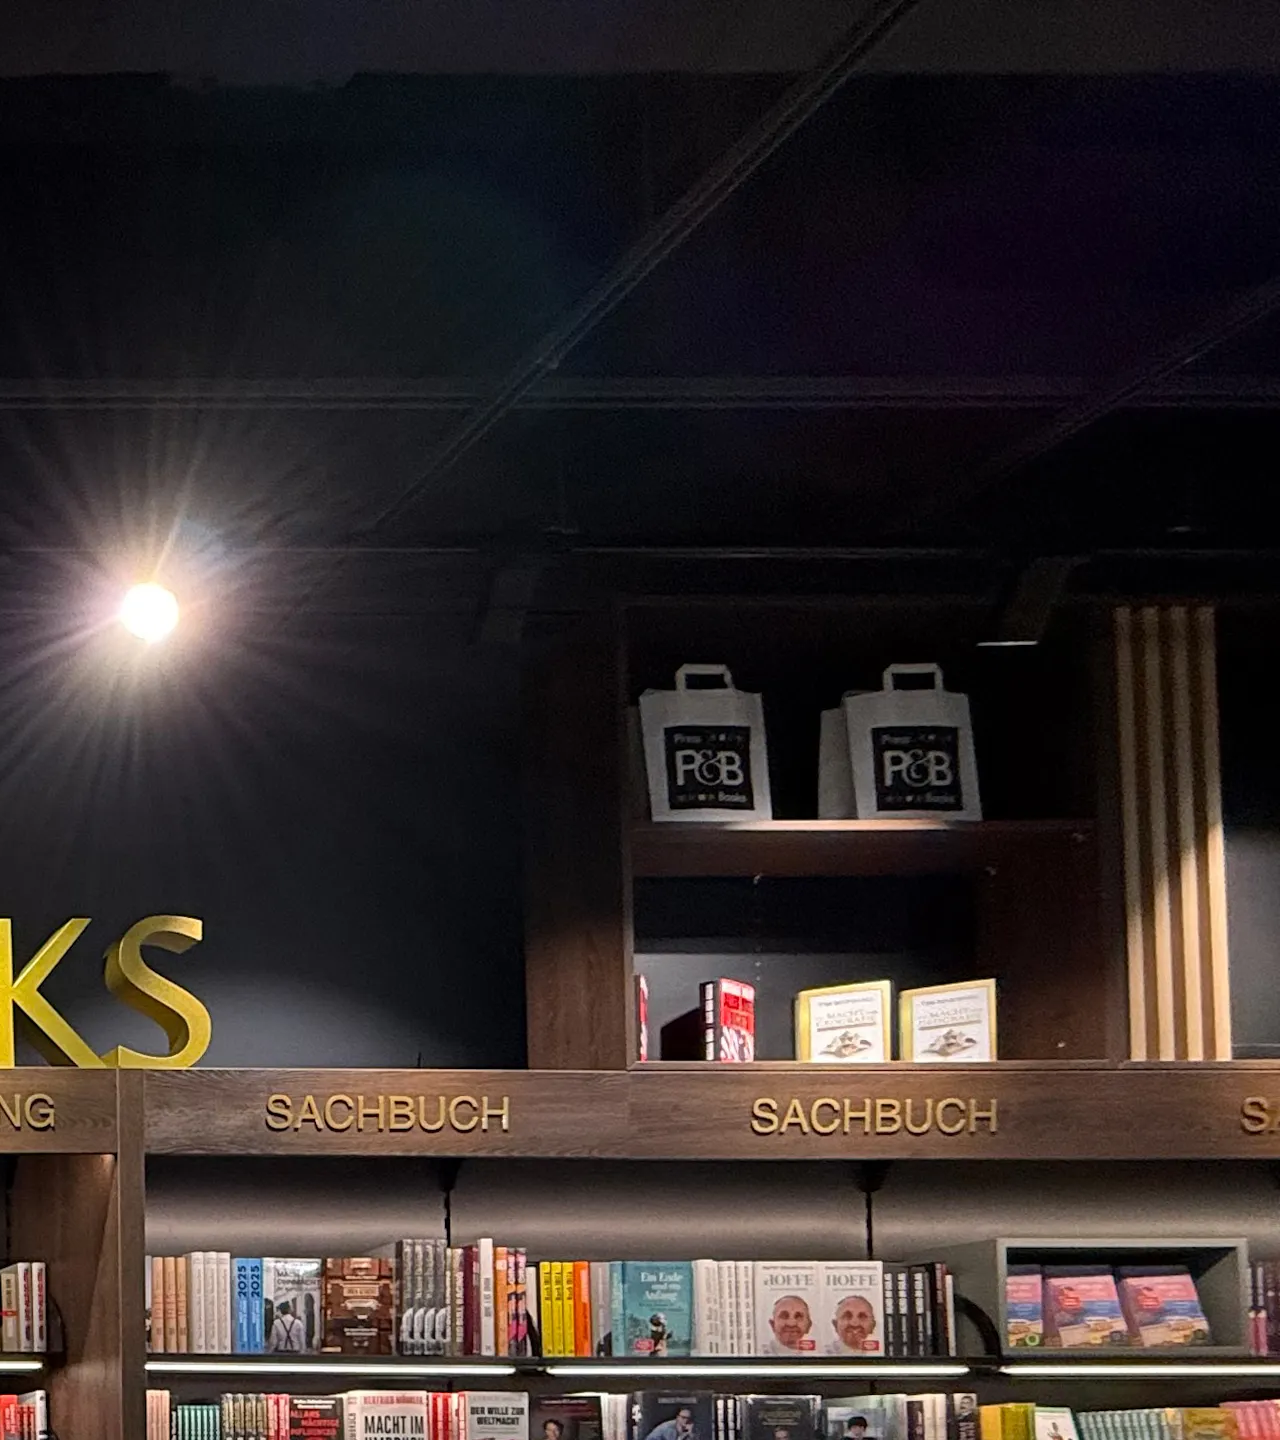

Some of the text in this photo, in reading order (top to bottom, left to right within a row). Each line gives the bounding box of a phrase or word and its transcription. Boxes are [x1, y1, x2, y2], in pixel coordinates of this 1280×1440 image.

[675, 750, 743, 786] P&B
[884, 750, 952, 787] P&B
[265, 1094, 510, 1133] SACHBUCH
[751, 1097, 998, 1135] SACHBUCH
[237, 1265, 248, 1297] 2025
[250, 1265, 261, 1297] 2025
[364, 1415, 424, 1435] MACHT IM
[476, 1415, 521, 1425] WELTMACHT
